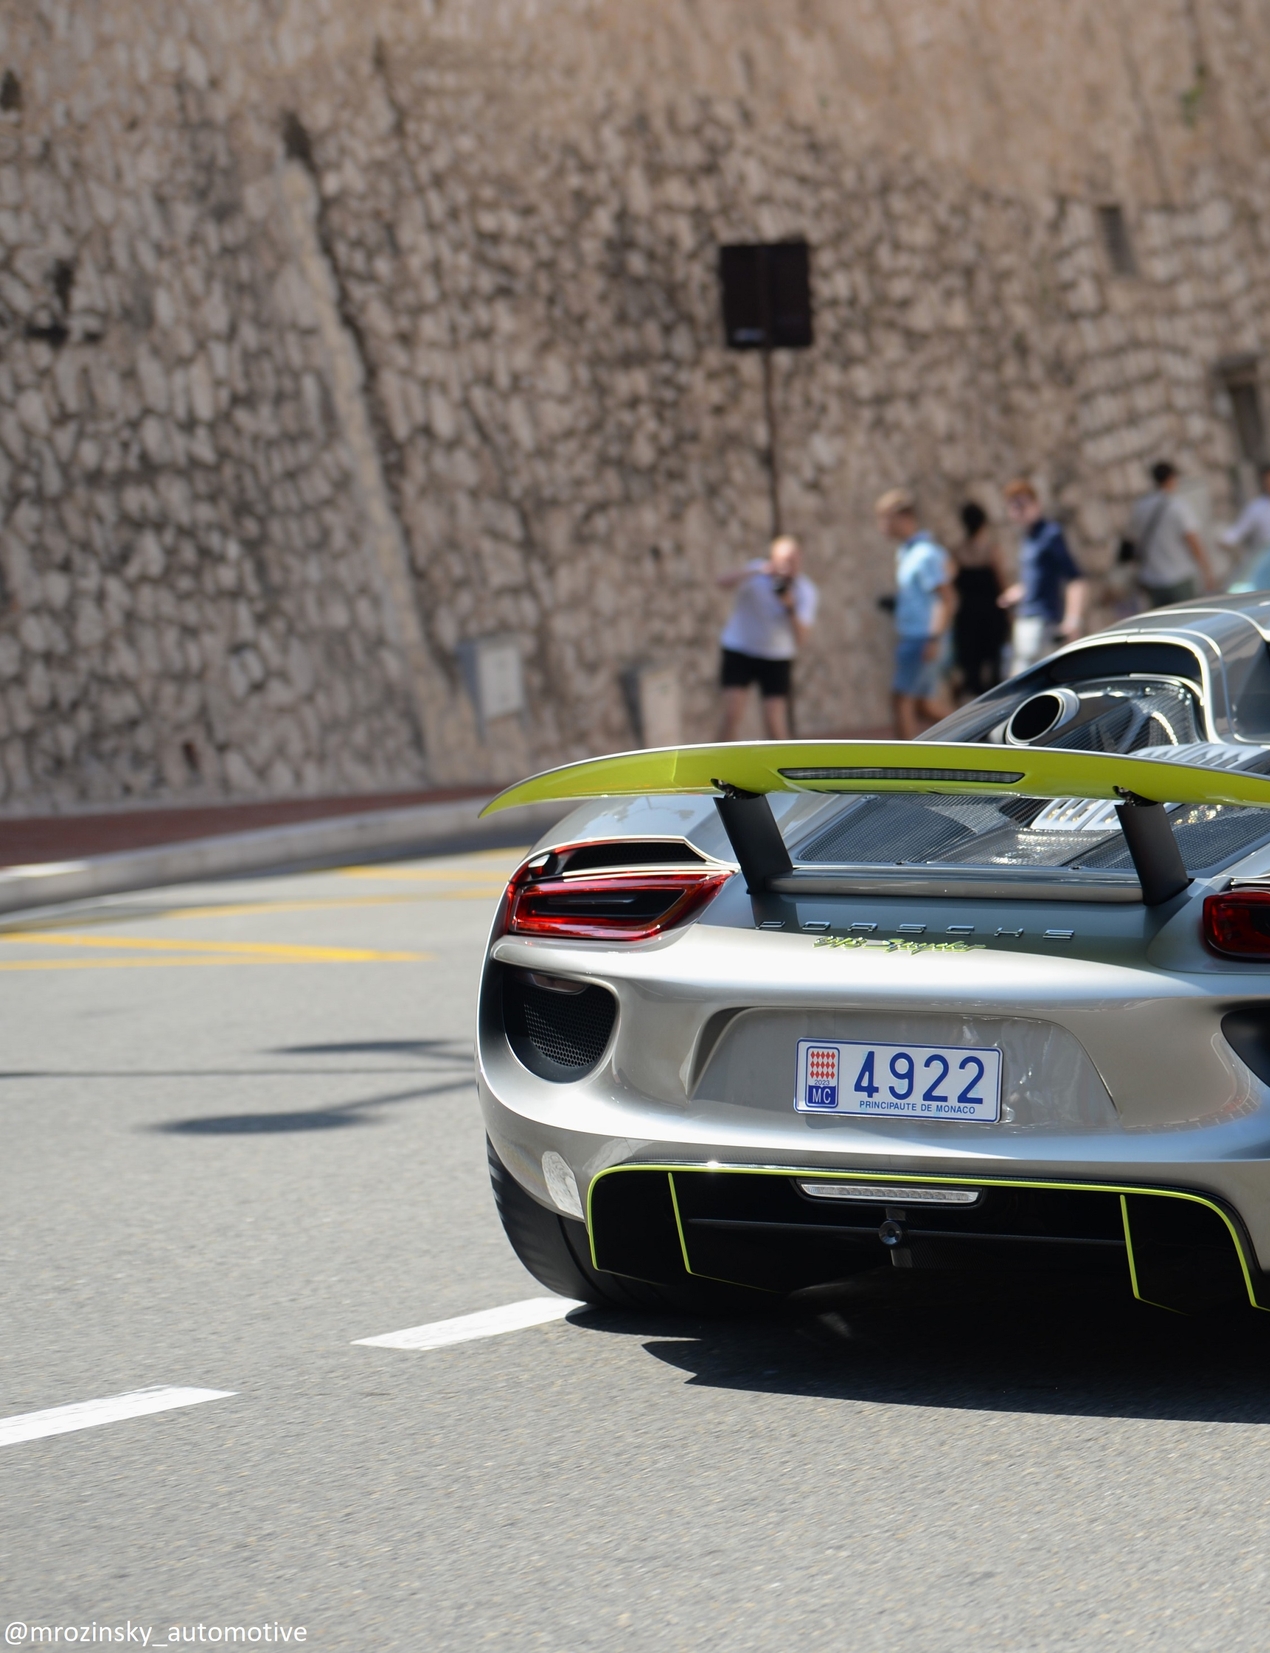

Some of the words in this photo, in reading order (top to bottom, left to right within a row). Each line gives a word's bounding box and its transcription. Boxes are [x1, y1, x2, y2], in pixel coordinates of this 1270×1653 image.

[755, 920, 1075, 940] PORSCHE
[853, 1050, 985, 1105] 4922
[812, 1087, 832, 1104] MC
[859, 1100, 917, 1111] PRINCIPAUTE
[920, 1103, 933, 1112] DE
[935, 1104, 976, 1115] MONACO
